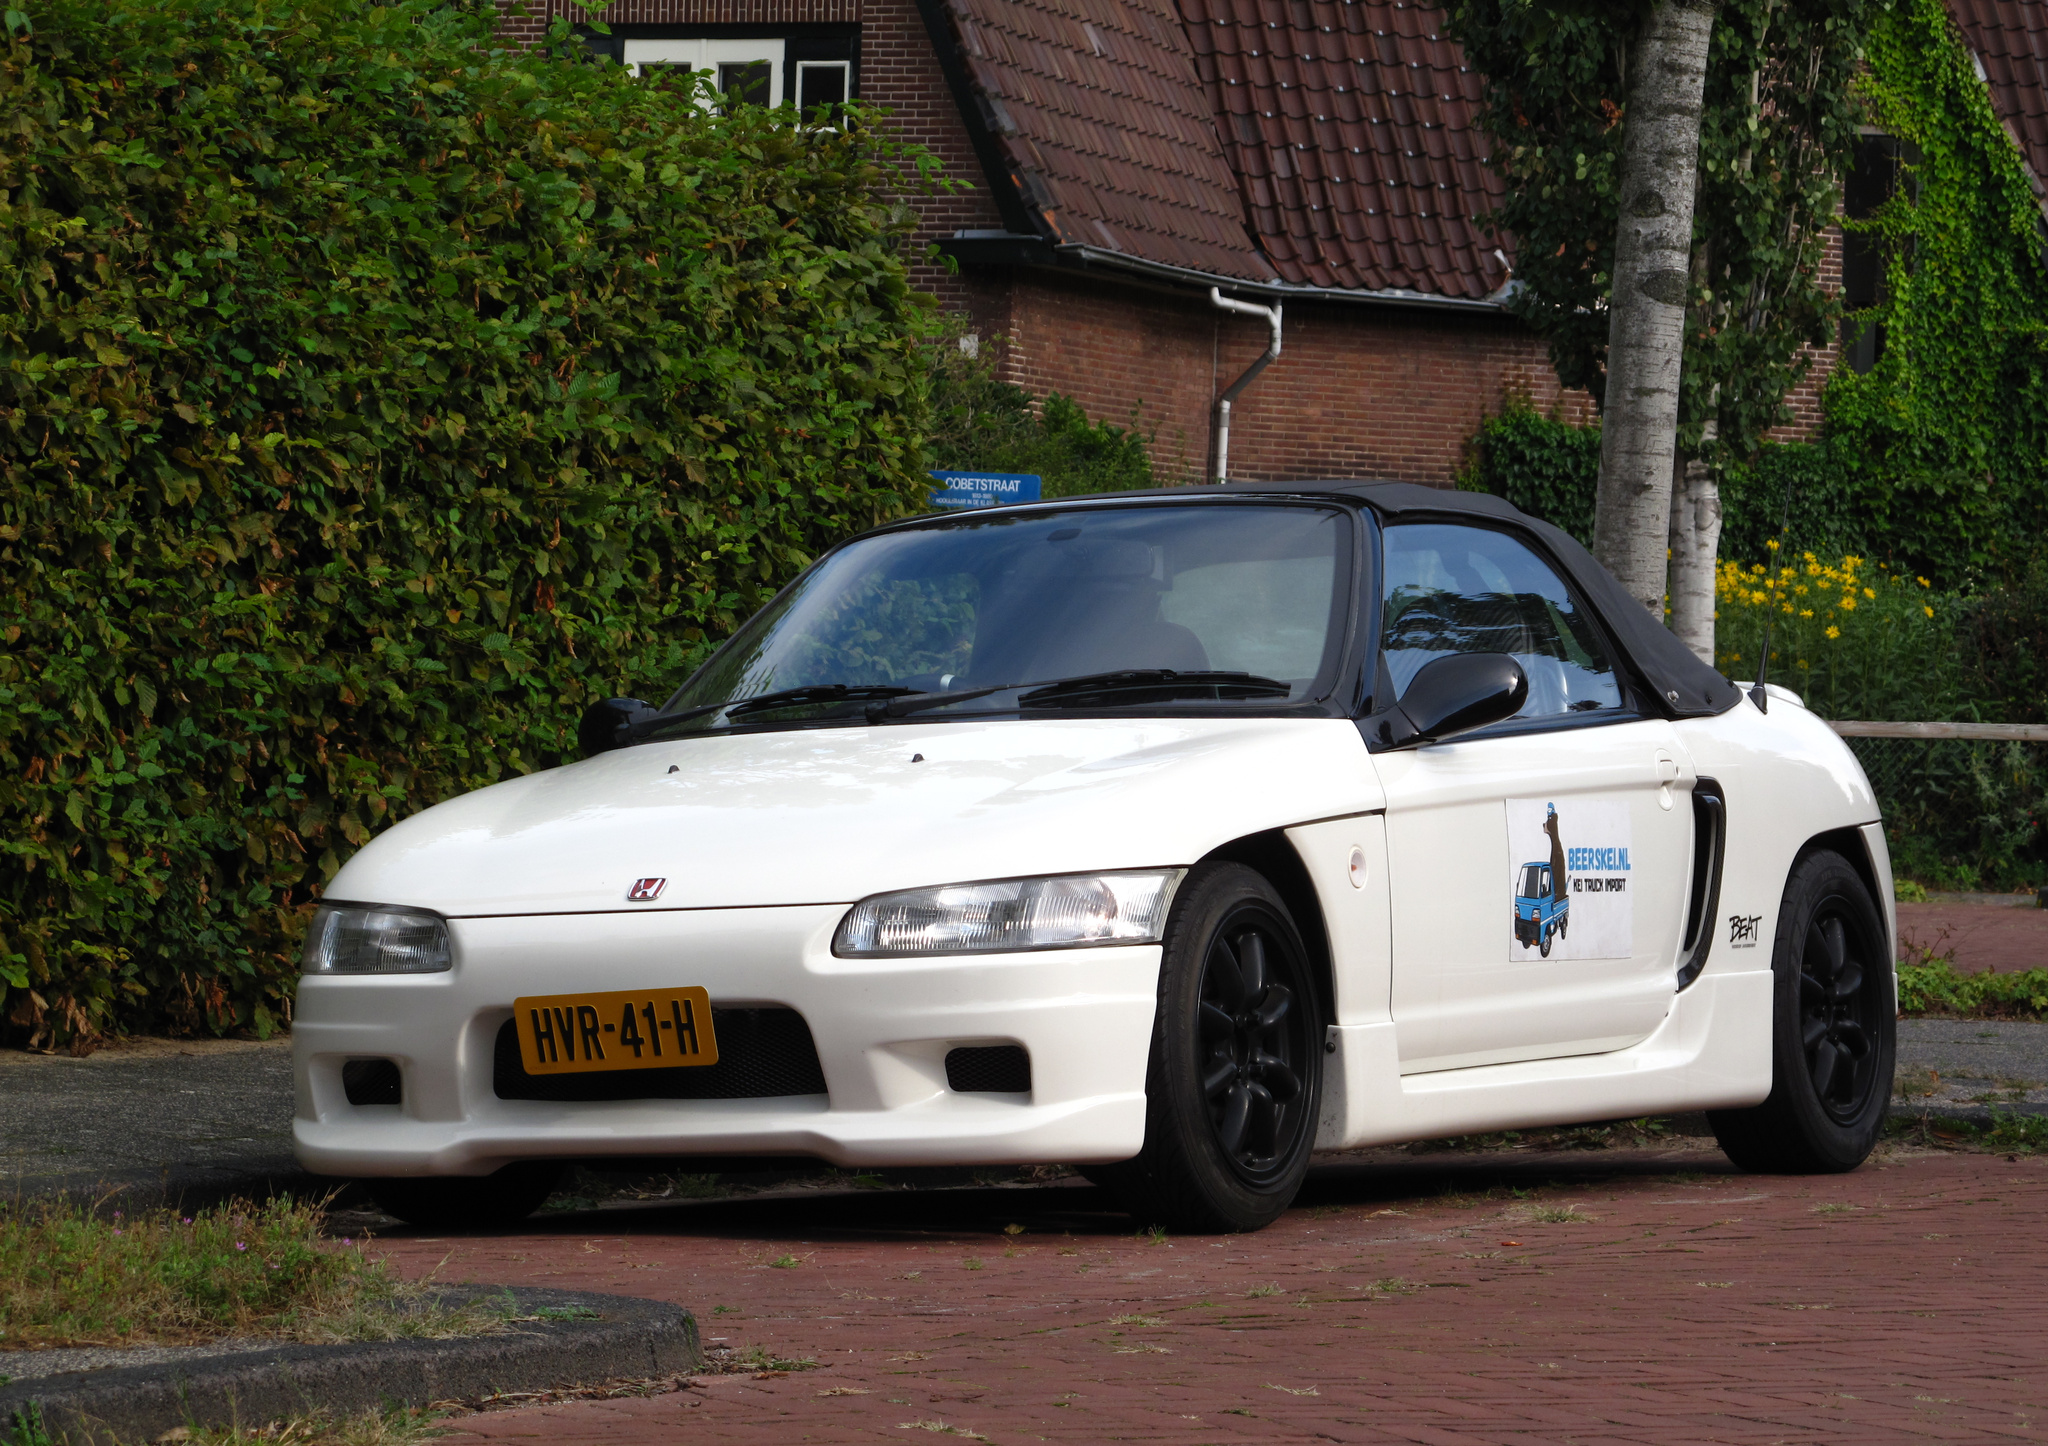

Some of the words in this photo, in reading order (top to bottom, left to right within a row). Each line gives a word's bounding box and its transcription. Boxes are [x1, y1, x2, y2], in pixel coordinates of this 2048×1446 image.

[945, 477, 1021, 492] COBETSTRAAT
[1568, 848, 1631, 871] BEERSKEI.NL
[1573, 878, 1583, 892] KEI
[1584, 878, 1604, 892] TRUCK
[1605, 878, 1627, 892] IMPORT
[1729, 914, 1762, 942] BEAT
[530, 998, 700, 1063] HVR-41-H
